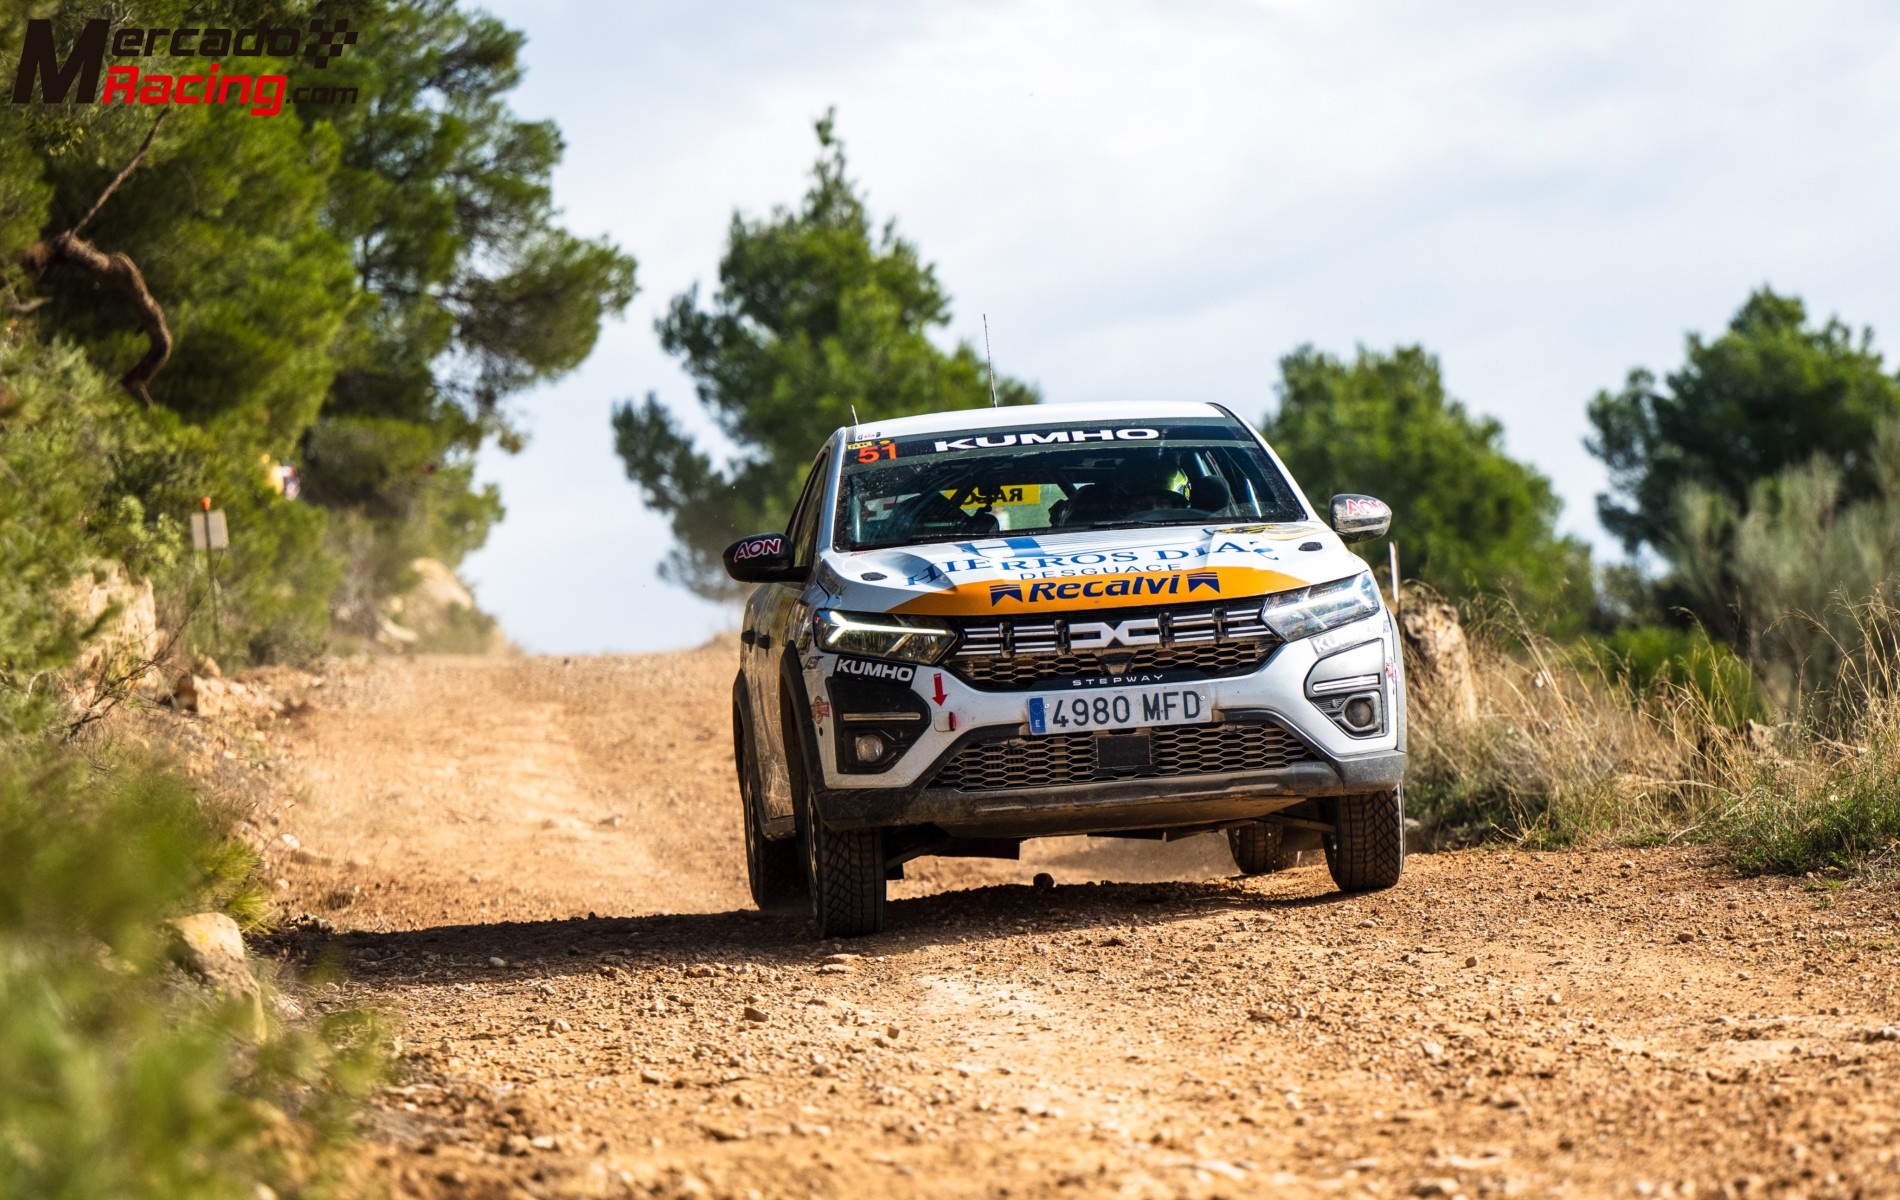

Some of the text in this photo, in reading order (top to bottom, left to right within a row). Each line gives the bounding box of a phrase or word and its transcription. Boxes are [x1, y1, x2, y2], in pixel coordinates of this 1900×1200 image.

[934, 427, 1160, 452] KUMHO
[857, 443, 897, 464] 51
[734, 538, 781, 563] AON
[1020, 563, 1182, 580] DESGUACE
[1028, 574, 1181, 603] Recalvi
[836, 658, 914, 683] KUMHO
[1072, 674, 1163, 686] STEPWAY
[1034, 690, 1201, 729] E 4980 MFD
